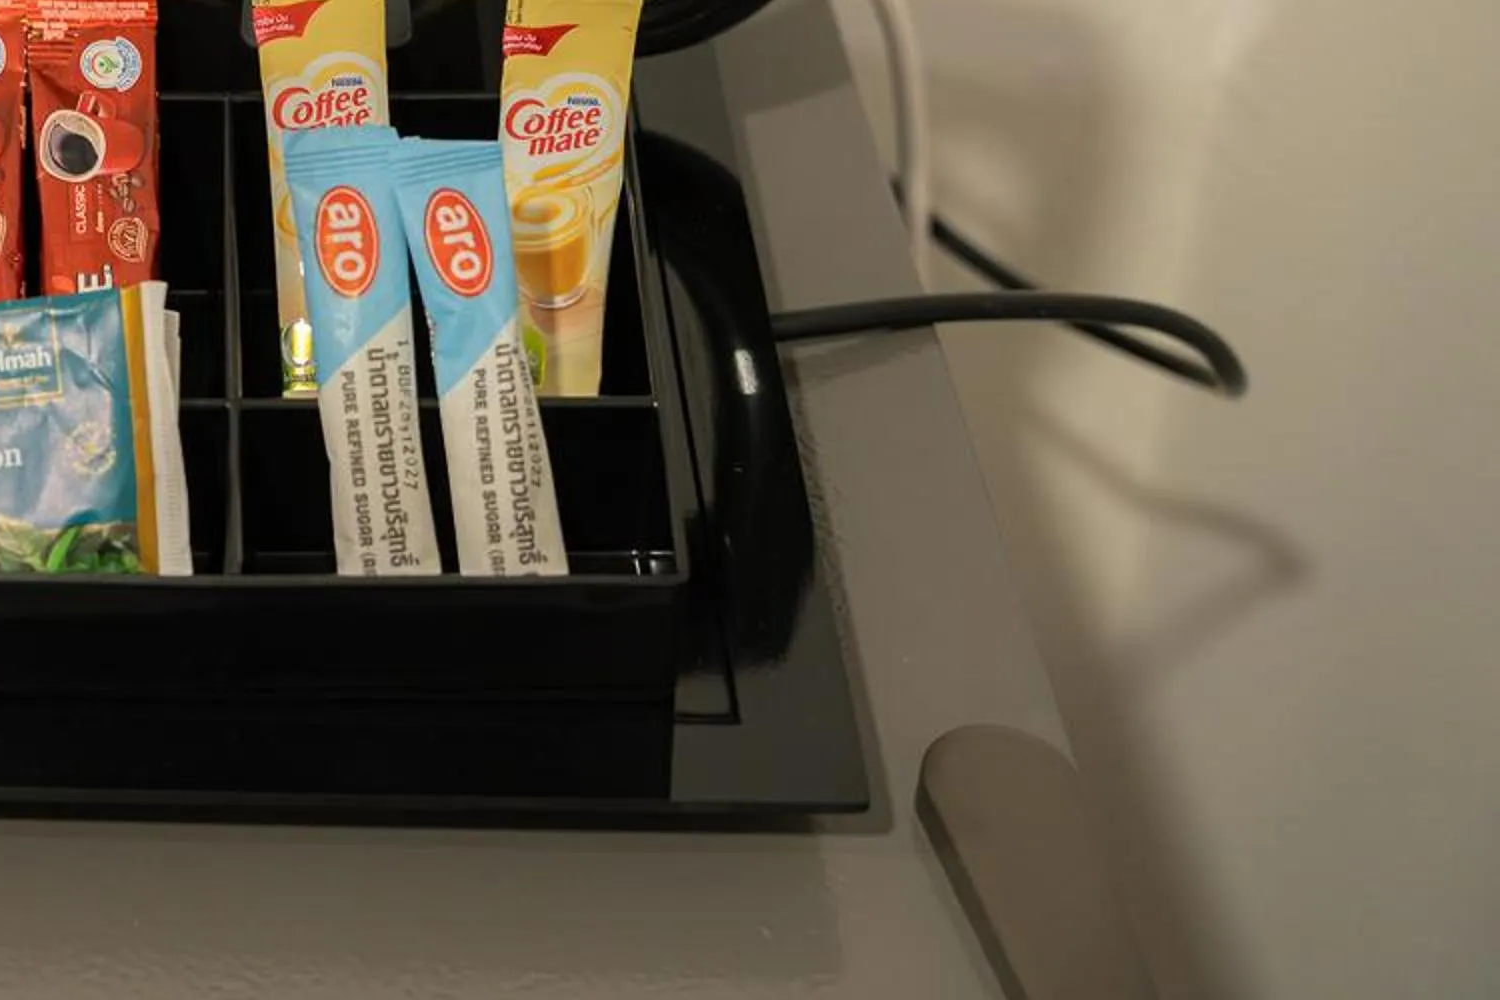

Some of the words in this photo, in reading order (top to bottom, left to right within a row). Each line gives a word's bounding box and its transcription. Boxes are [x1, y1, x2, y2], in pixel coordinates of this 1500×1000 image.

[272, 86, 369, 131] Coffee
[310, 107, 371, 129] ate
[504, 98, 602, 141] Coffee
[527, 128, 600, 157] mate
[74, 184, 88, 235] CLASSIC
[326, 201, 368, 282] aro
[436, 201, 483, 280] aro
[341, 370, 358, 413] PURE
[473, 368, 489, 411] PURE
[347, 418, 367, 488] REFINED
[475, 414, 496, 485] REFINED
[354, 492, 374, 549] SUGAR
[482, 489, 502, 546] SUGAR
